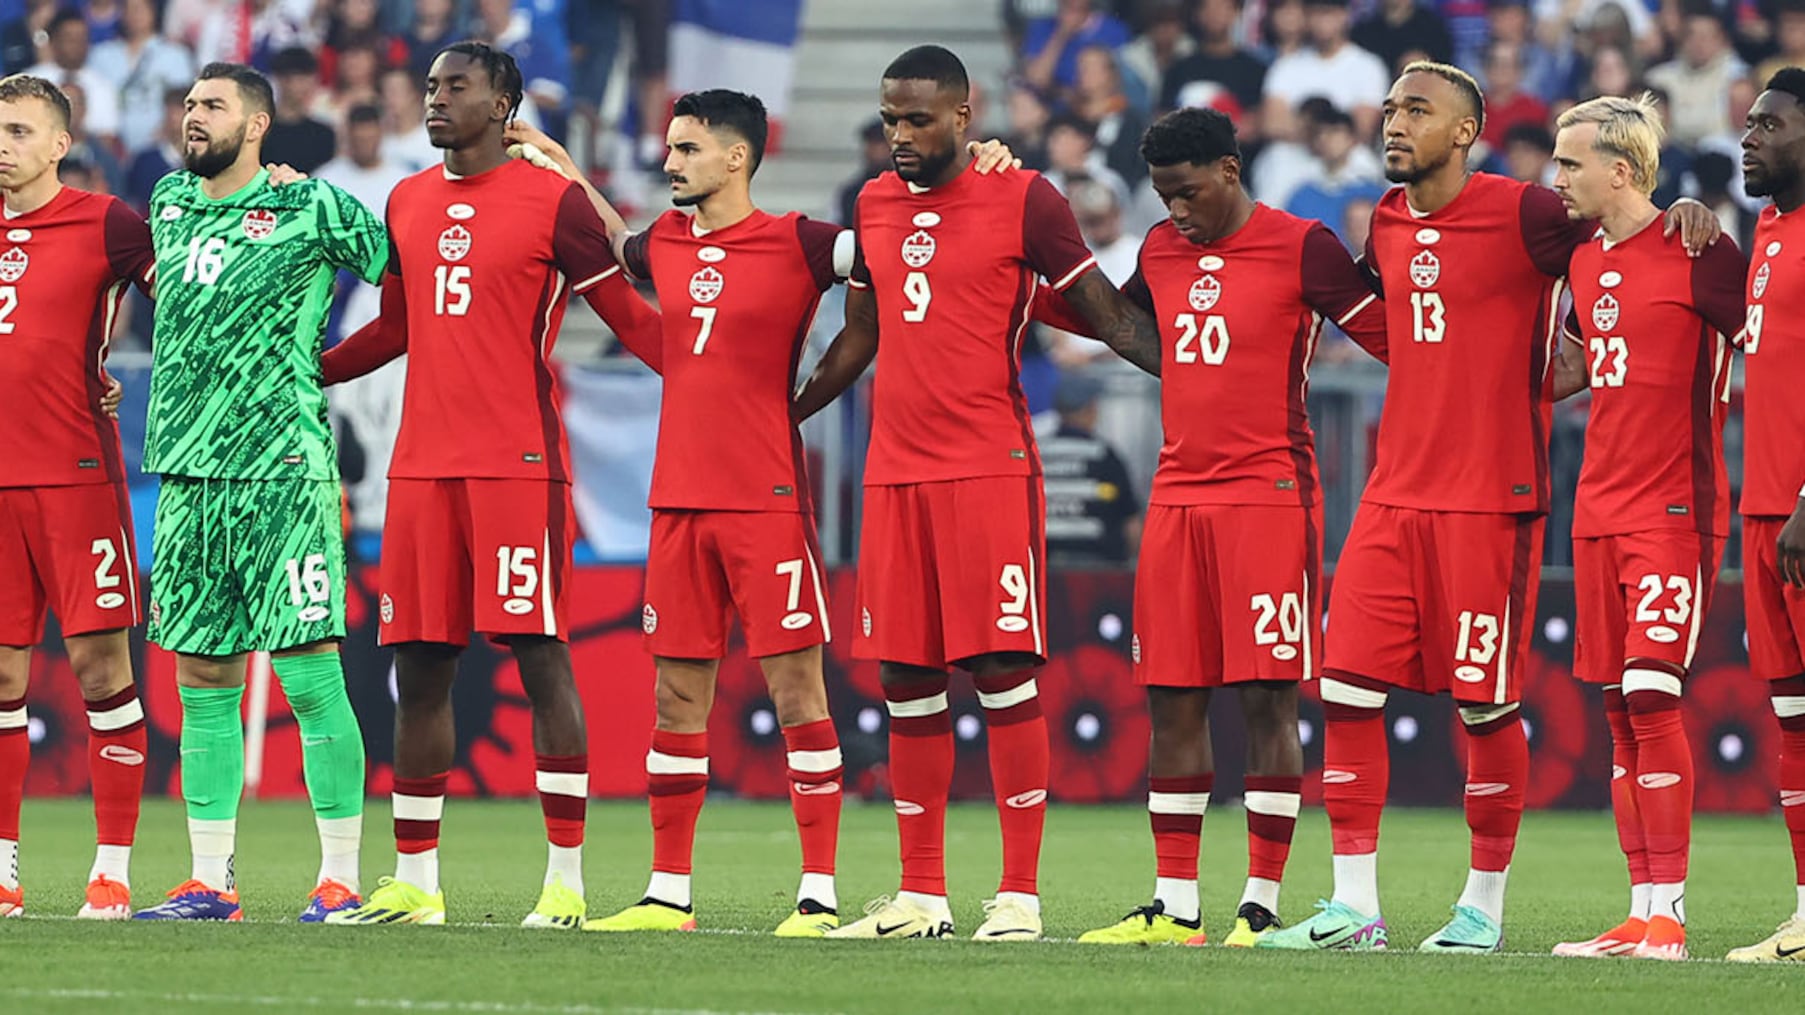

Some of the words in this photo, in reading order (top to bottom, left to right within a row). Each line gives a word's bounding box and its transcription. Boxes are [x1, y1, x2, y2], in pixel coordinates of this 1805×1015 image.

[182, 236, 227, 286] 16
[0, 286, 18, 334] 2
[434, 265, 472, 315] 15
[903, 272, 932, 322] 9
[690, 306, 717, 355] 7
[1174, 313, 1230, 365] 20
[1410, 292, 1446, 342] 13
[1589, 337, 1629, 388] 23
[91, 538, 120, 589] 2
[284, 553, 331, 608] 16
[497, 546, 538, 597] 15
[776, 559, 803, 611] 7
[1000, 564, 1028, 614] 9
[1251, 593, 1303, 646] 20
[1635, 574, 1692, 625] 23
[1455, 611, 1499, 664] 13
